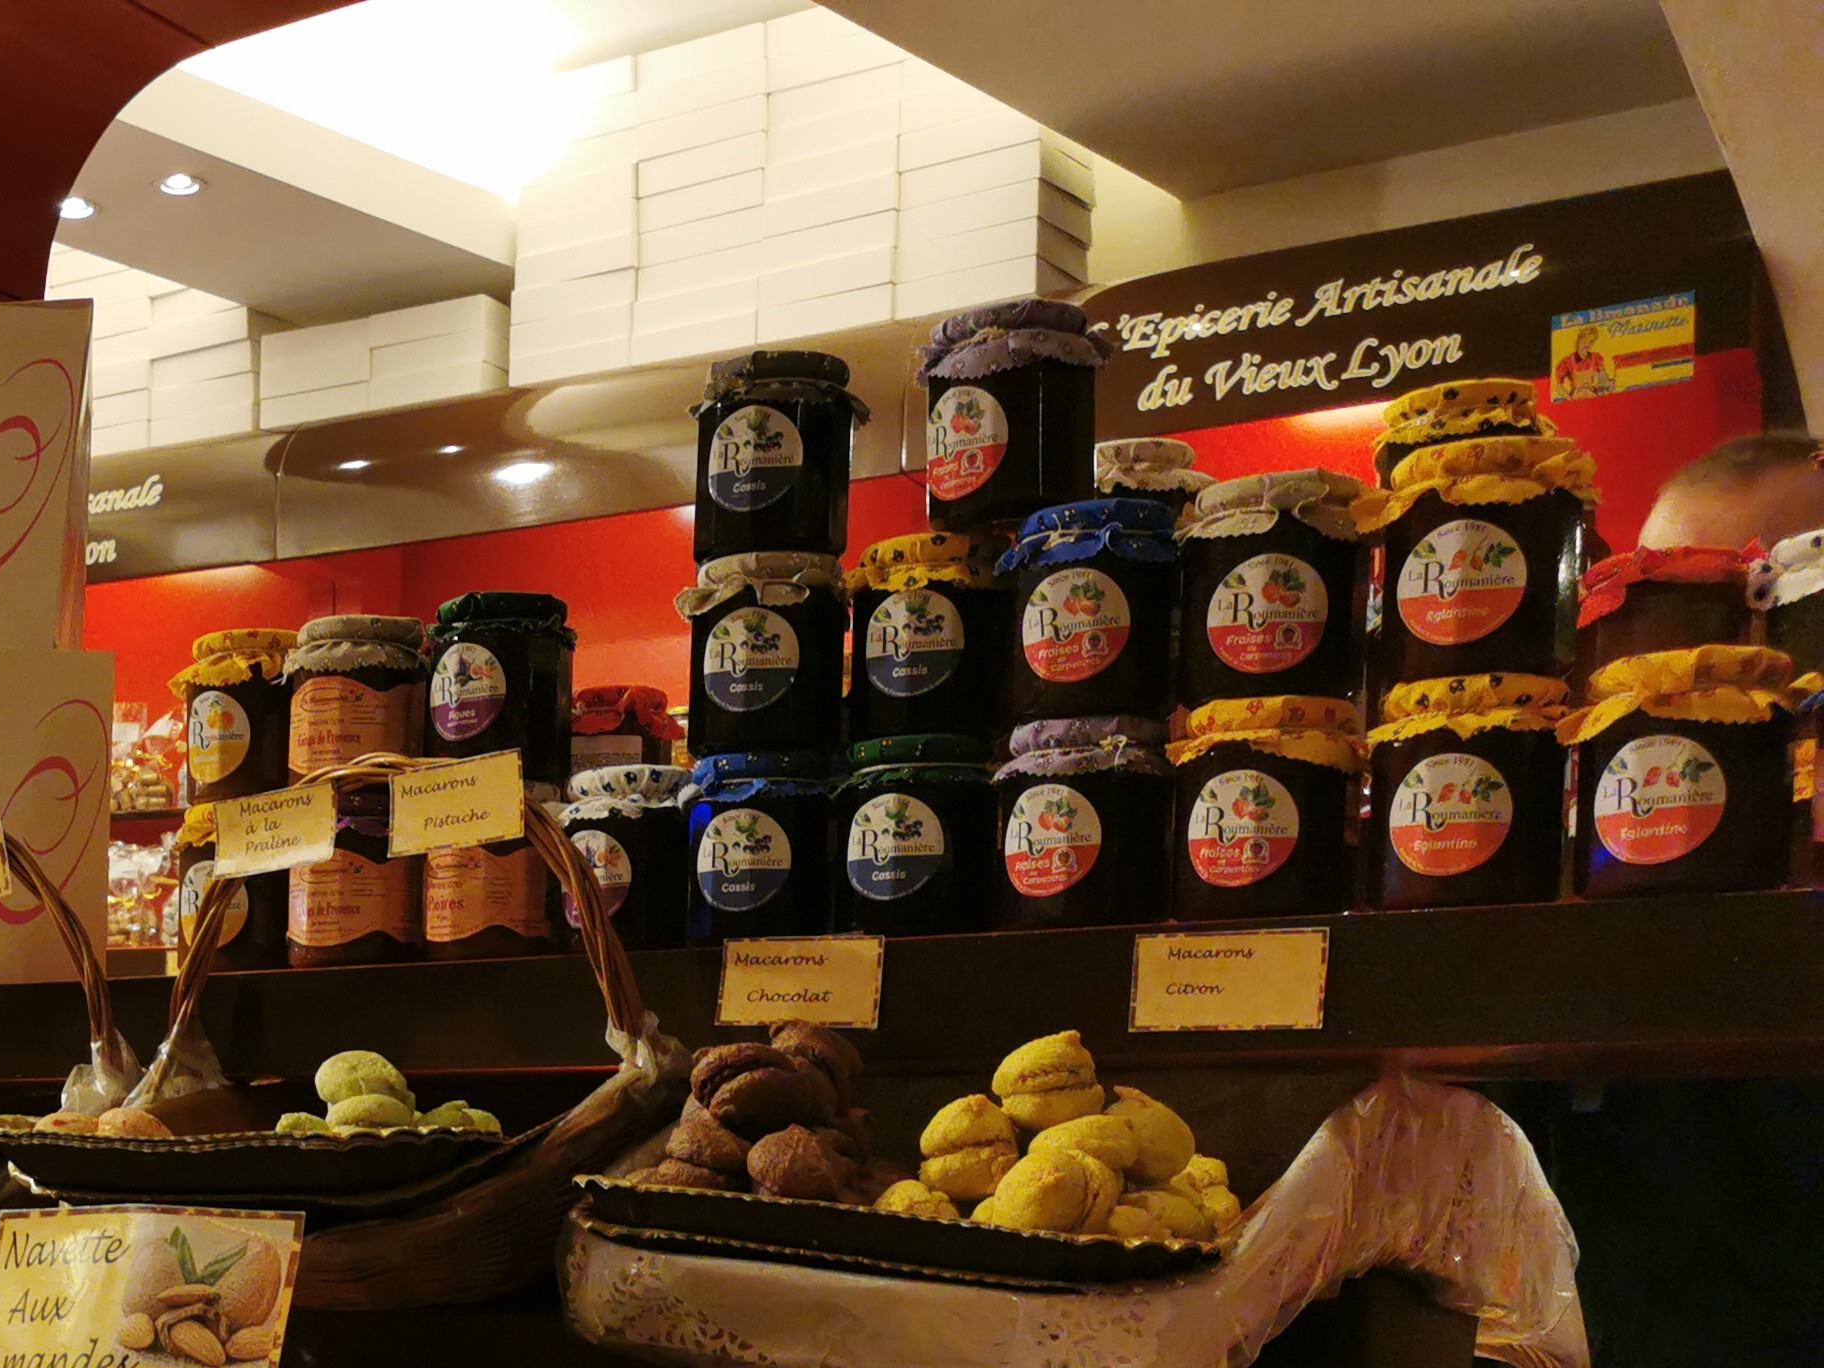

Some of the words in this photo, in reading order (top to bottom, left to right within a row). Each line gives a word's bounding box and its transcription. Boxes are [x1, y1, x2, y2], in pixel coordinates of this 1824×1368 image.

[1294, 243, 1545, 328] Artisanale
[1136, 365, 1194, 412] du
[1204, 350, 1339, 400] Vieux
[1341, 332, 1464, 388] Lyon
[87, 473, 165, 516] anale
[732, 480, 767, 494] Cassis
[86, 536, 118, 567] on
[892, 663, 929, 679] Cassis
[729, 680, 764, 694] Cassis
[400, 774, 479, 800] Macarons
[239, 792, 314, 818] Macarons
[244, 818, 257, 835] à
[263, 816, 282, 833] la
[422, 807, 492, 831] Pistache
[244, 835, 302, 856] Praline
[871, 868, 907, 882] Cassis
[721, 881, 756, 893] Cassis
[732, 950, 829, 969] Macarons
[1167, 943, 1256, 961] Macarons
[746, 986, 834, 1005] Chocolat
[1164, 980, 1227, 997] Citron
[3, 1228, 129, 1271] Navette
[8, 1287, 78, 1327] Aux
